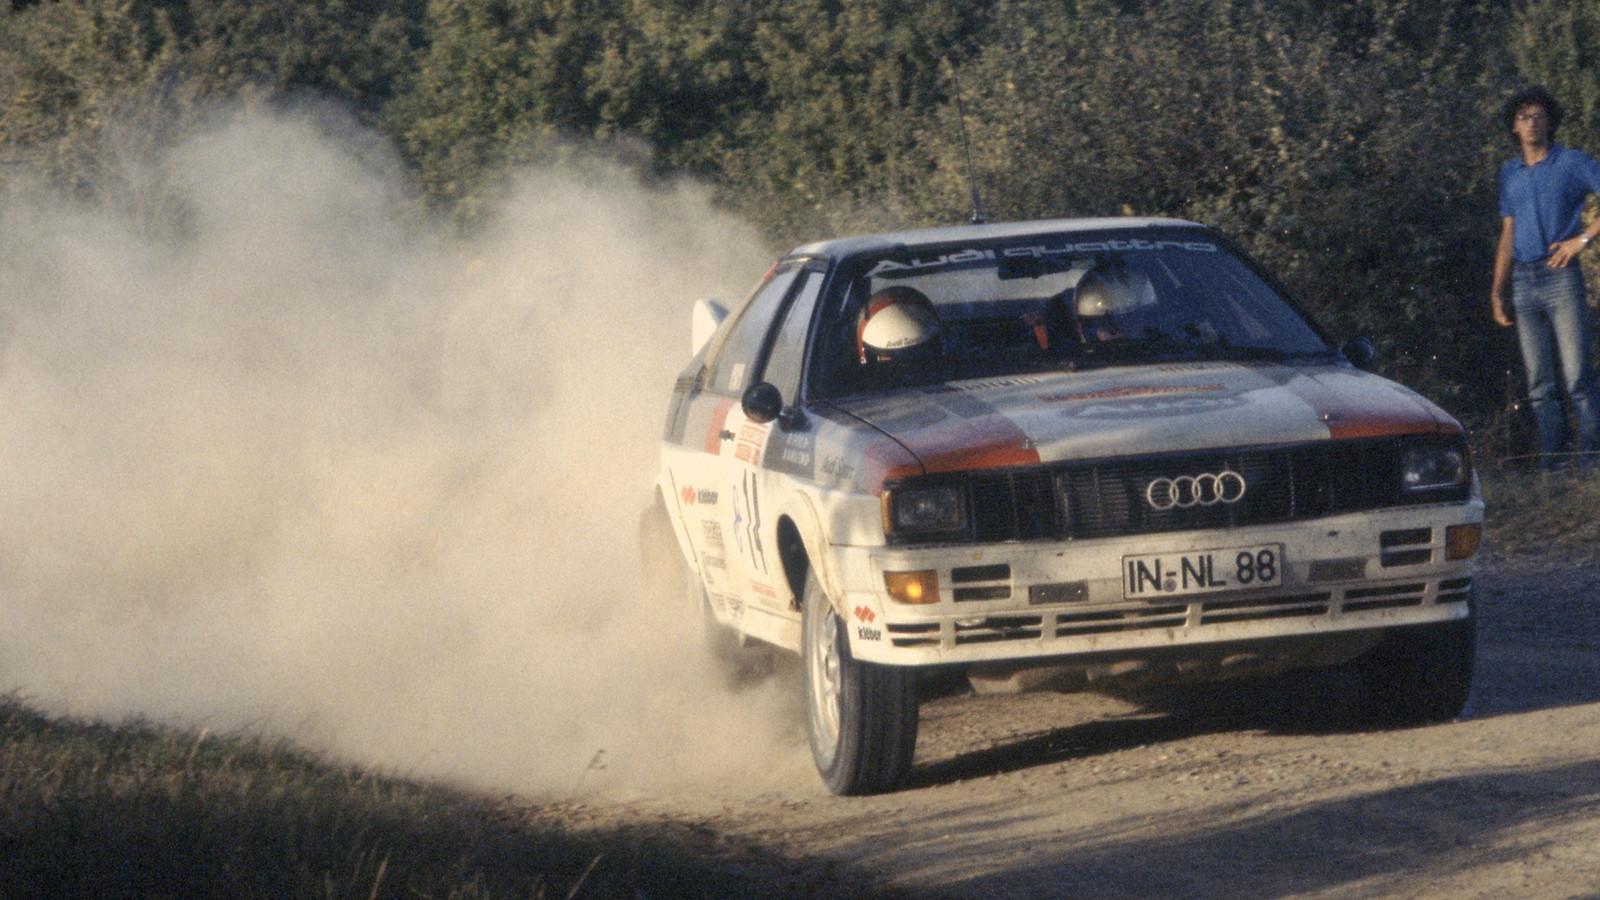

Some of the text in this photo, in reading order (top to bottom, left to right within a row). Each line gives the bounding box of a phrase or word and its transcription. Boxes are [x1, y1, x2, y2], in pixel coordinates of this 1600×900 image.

[863, 239, 1218, 278] Audi quattro
[1128, 549, 1276, 593] IN-NL 88
